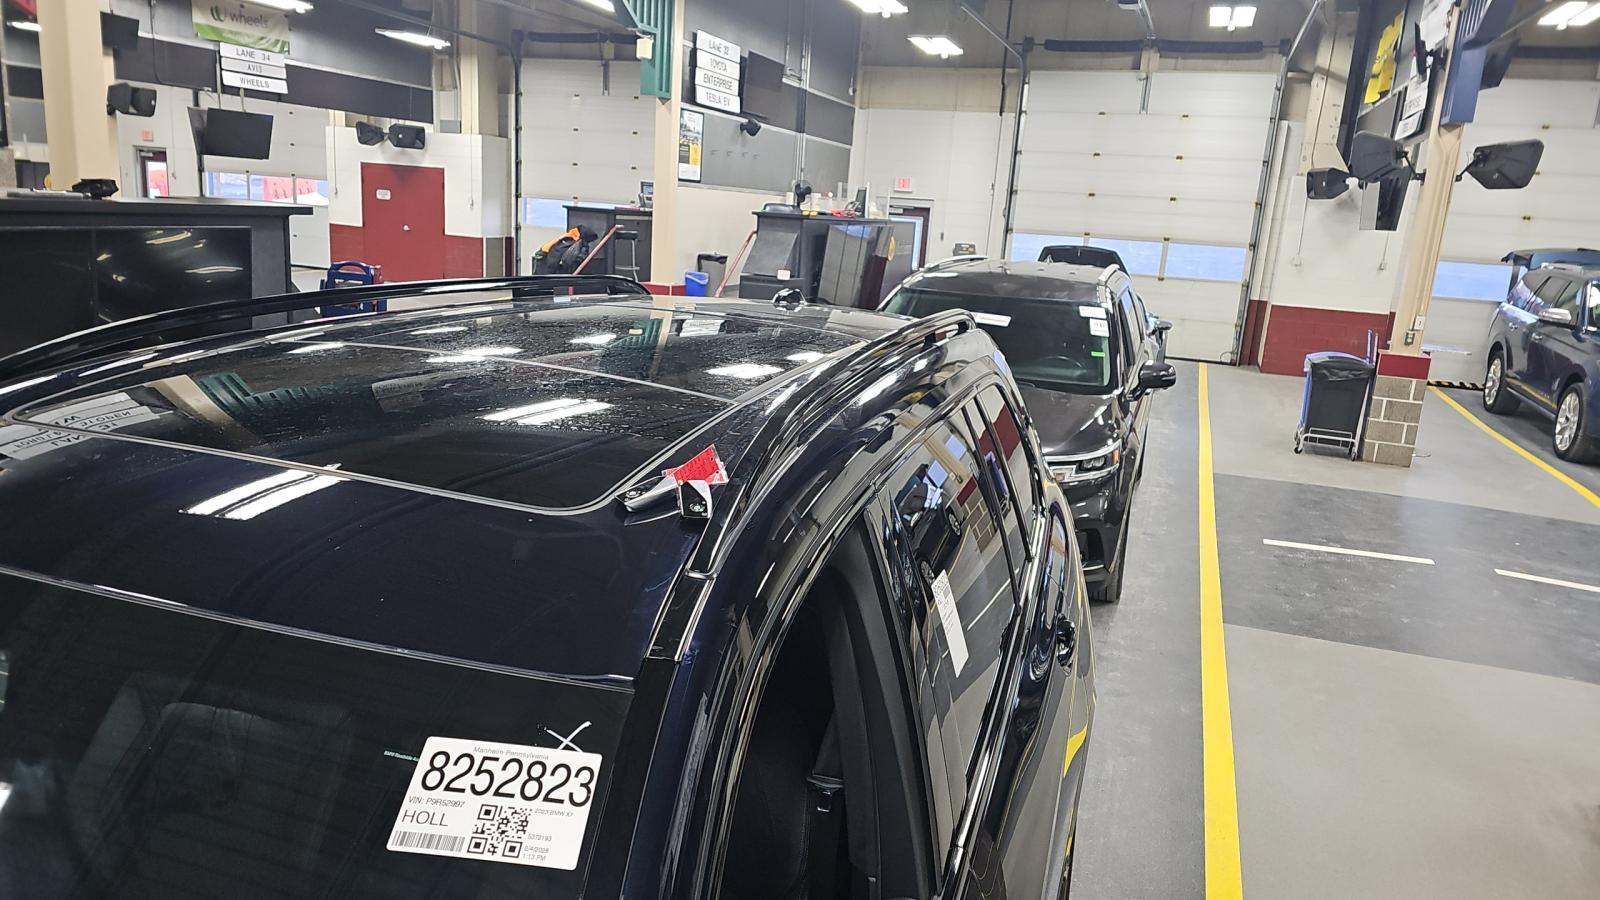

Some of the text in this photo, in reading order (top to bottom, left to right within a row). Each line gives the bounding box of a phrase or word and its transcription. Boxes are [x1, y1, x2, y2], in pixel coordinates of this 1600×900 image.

[236, 48, 256, 59] LANE
[709, 40, 722, 53] LANE
[710, 58, 728, 72] TOYOTA
[240, 77, 270, 89] WHEELS
[703, 73, 733, 91] ENTERPRISE
[706, 91, 721, 105] TESLA
[473, 746, 549, 761] Manheim Pennsylvania
[421, 750, 595, 808] 8252823
[408, 795, 424, 804] VIN:
[401, 809, 448, 827] HOLL
[549, 809, 565, 817] BMW
